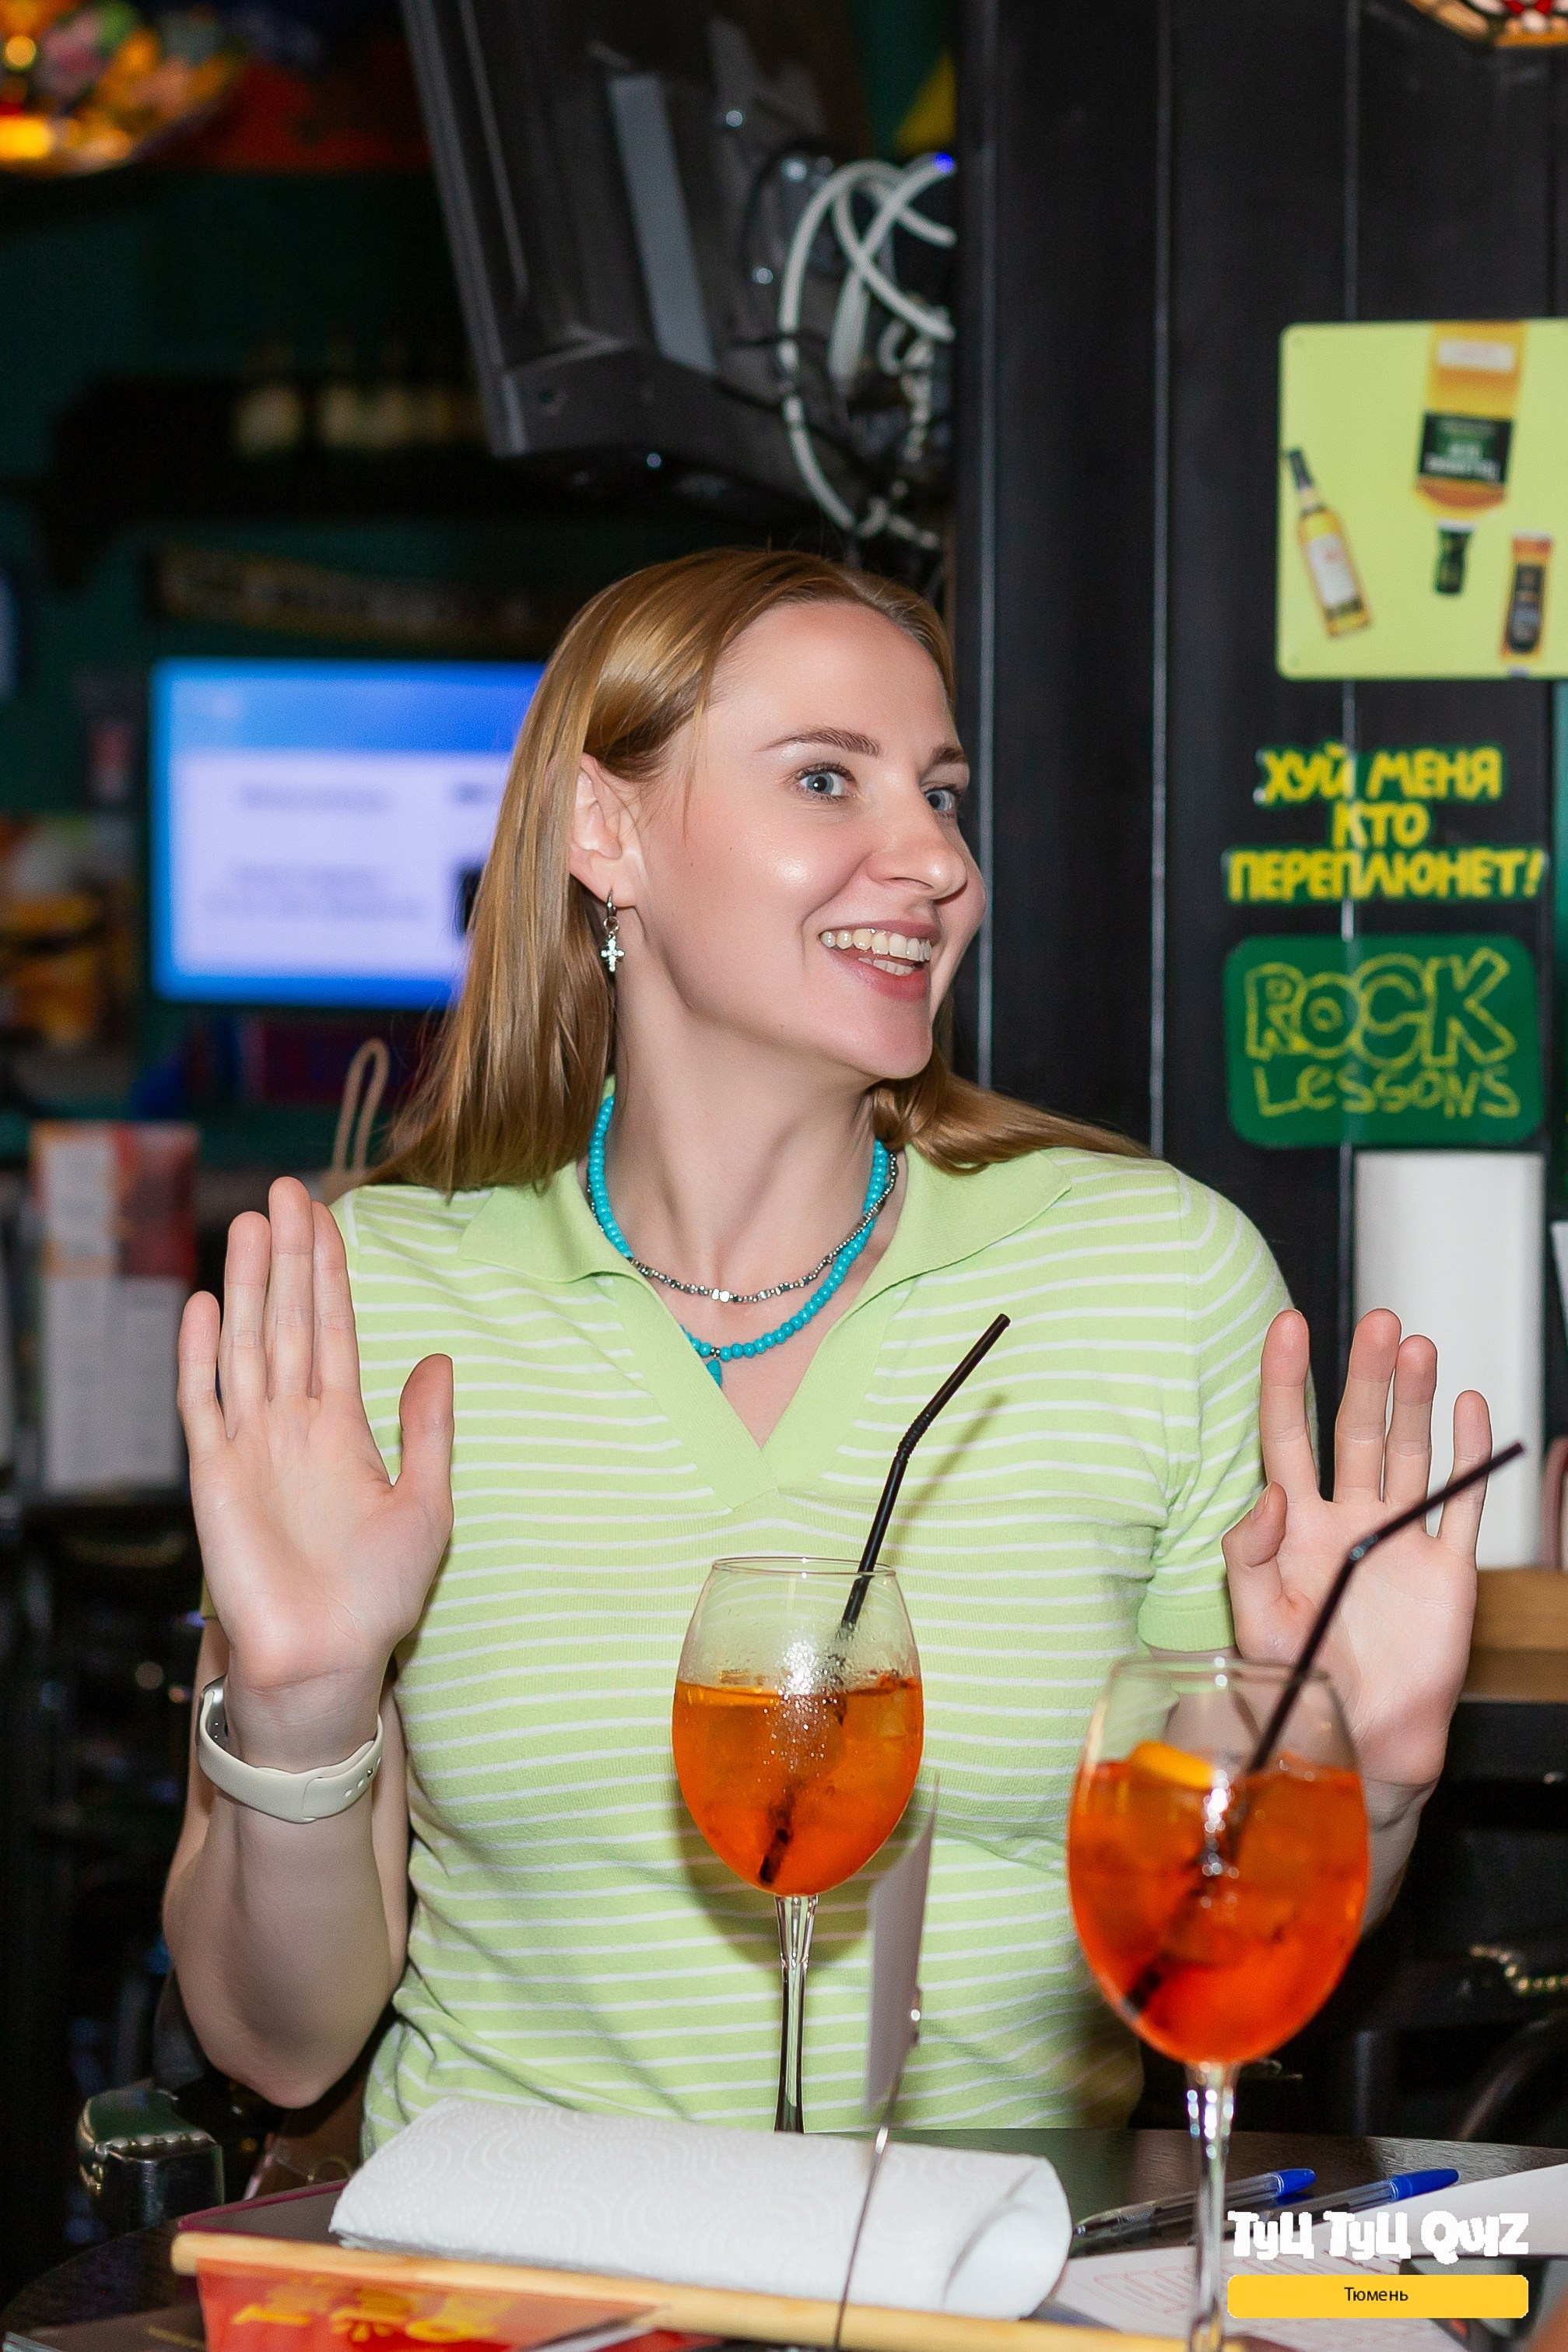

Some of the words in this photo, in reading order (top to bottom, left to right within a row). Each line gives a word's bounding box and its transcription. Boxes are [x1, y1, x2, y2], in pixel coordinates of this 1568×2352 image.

[1263, 742, 1356, 802] ХУЙ
[1366, 746, 1503, 800] МЕНЯ
[1331, 801, 1429, 848] КТО
[1229, 848, 1545, 901] ПЕРЕПЛЮНЕТ!
[1246, 947, 1517, 1069] ROCK
